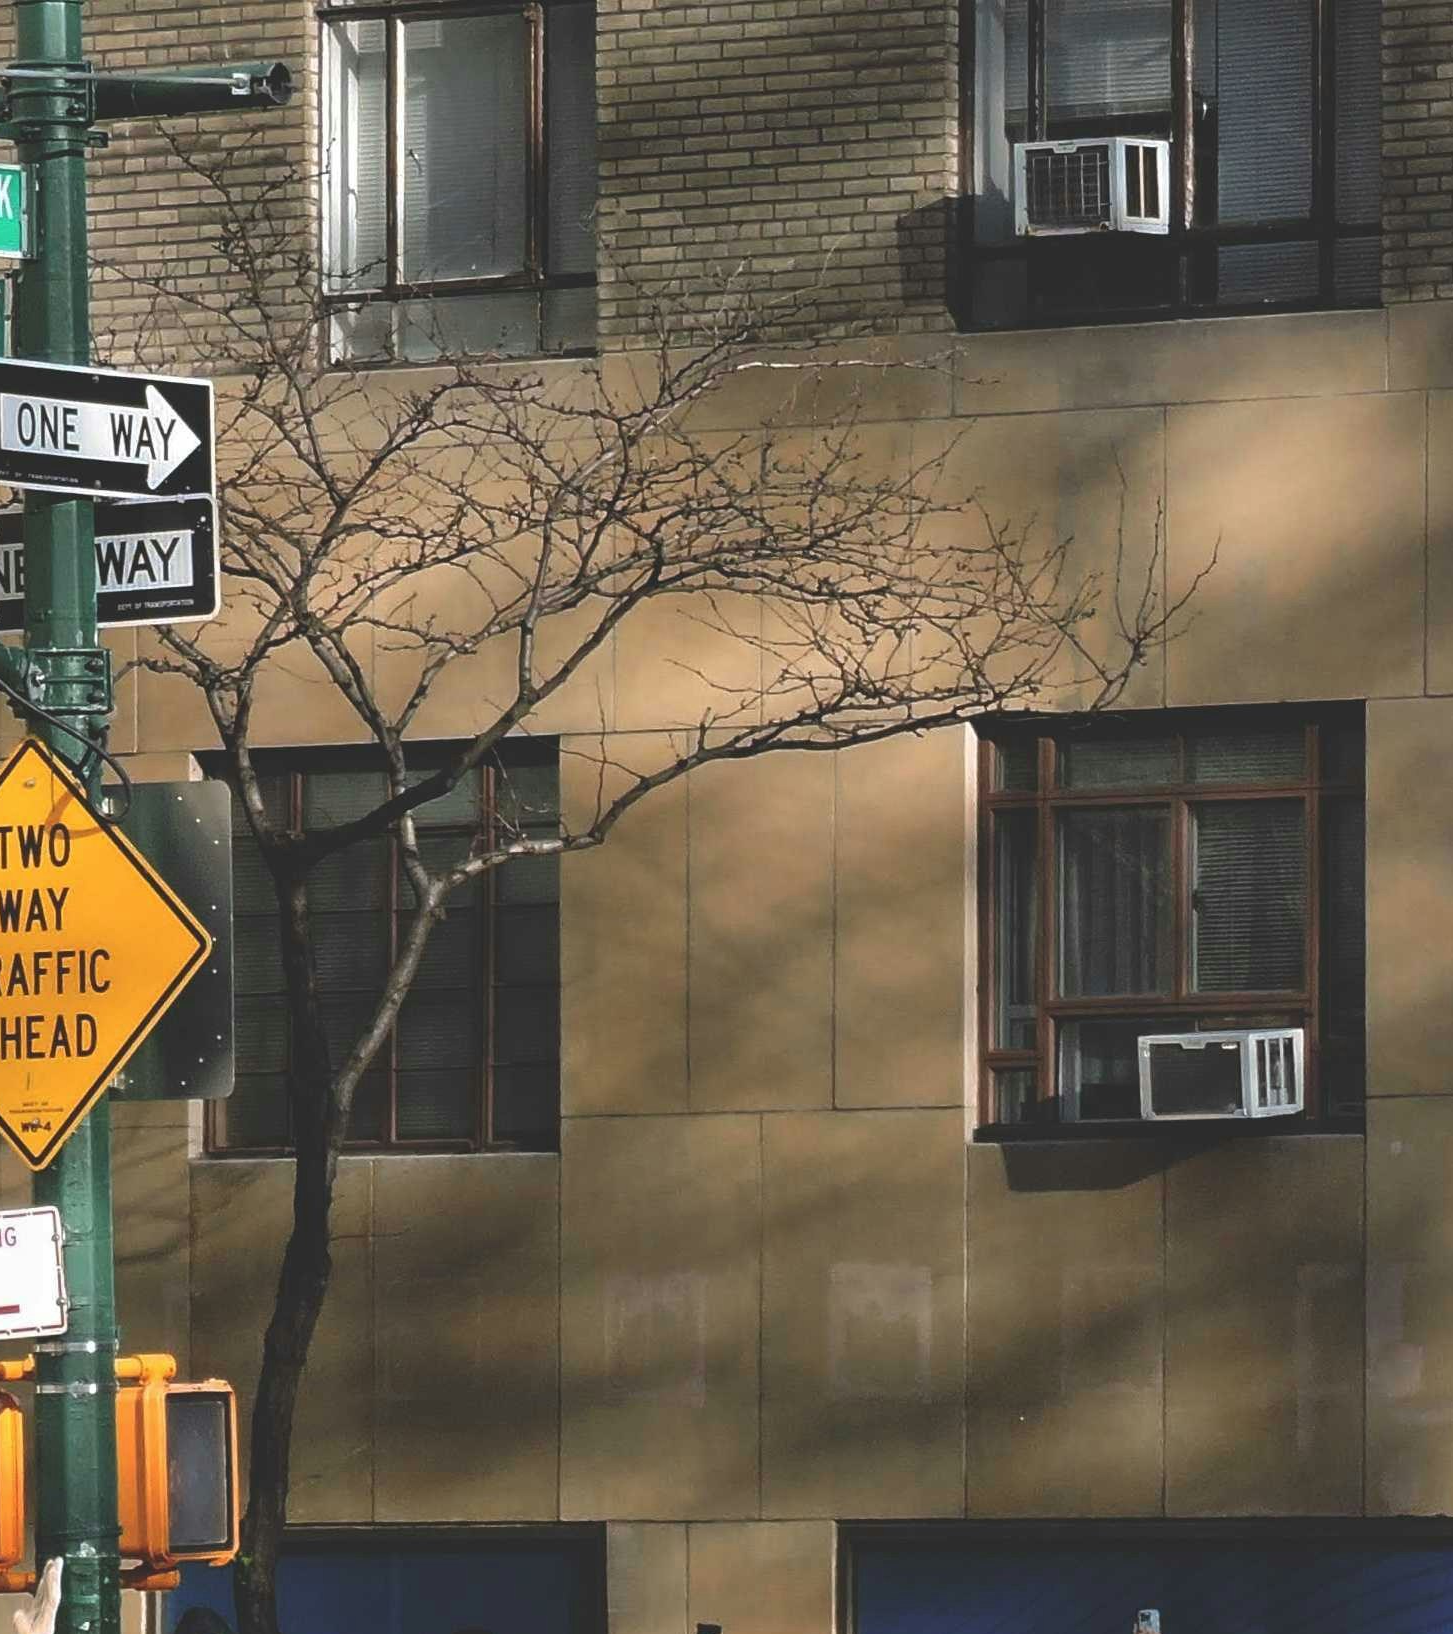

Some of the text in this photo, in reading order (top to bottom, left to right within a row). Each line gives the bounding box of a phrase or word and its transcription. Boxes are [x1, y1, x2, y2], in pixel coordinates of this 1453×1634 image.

[17, 402, 177, 461] ONE WAY
[96, 537, 180, 587] WAY
